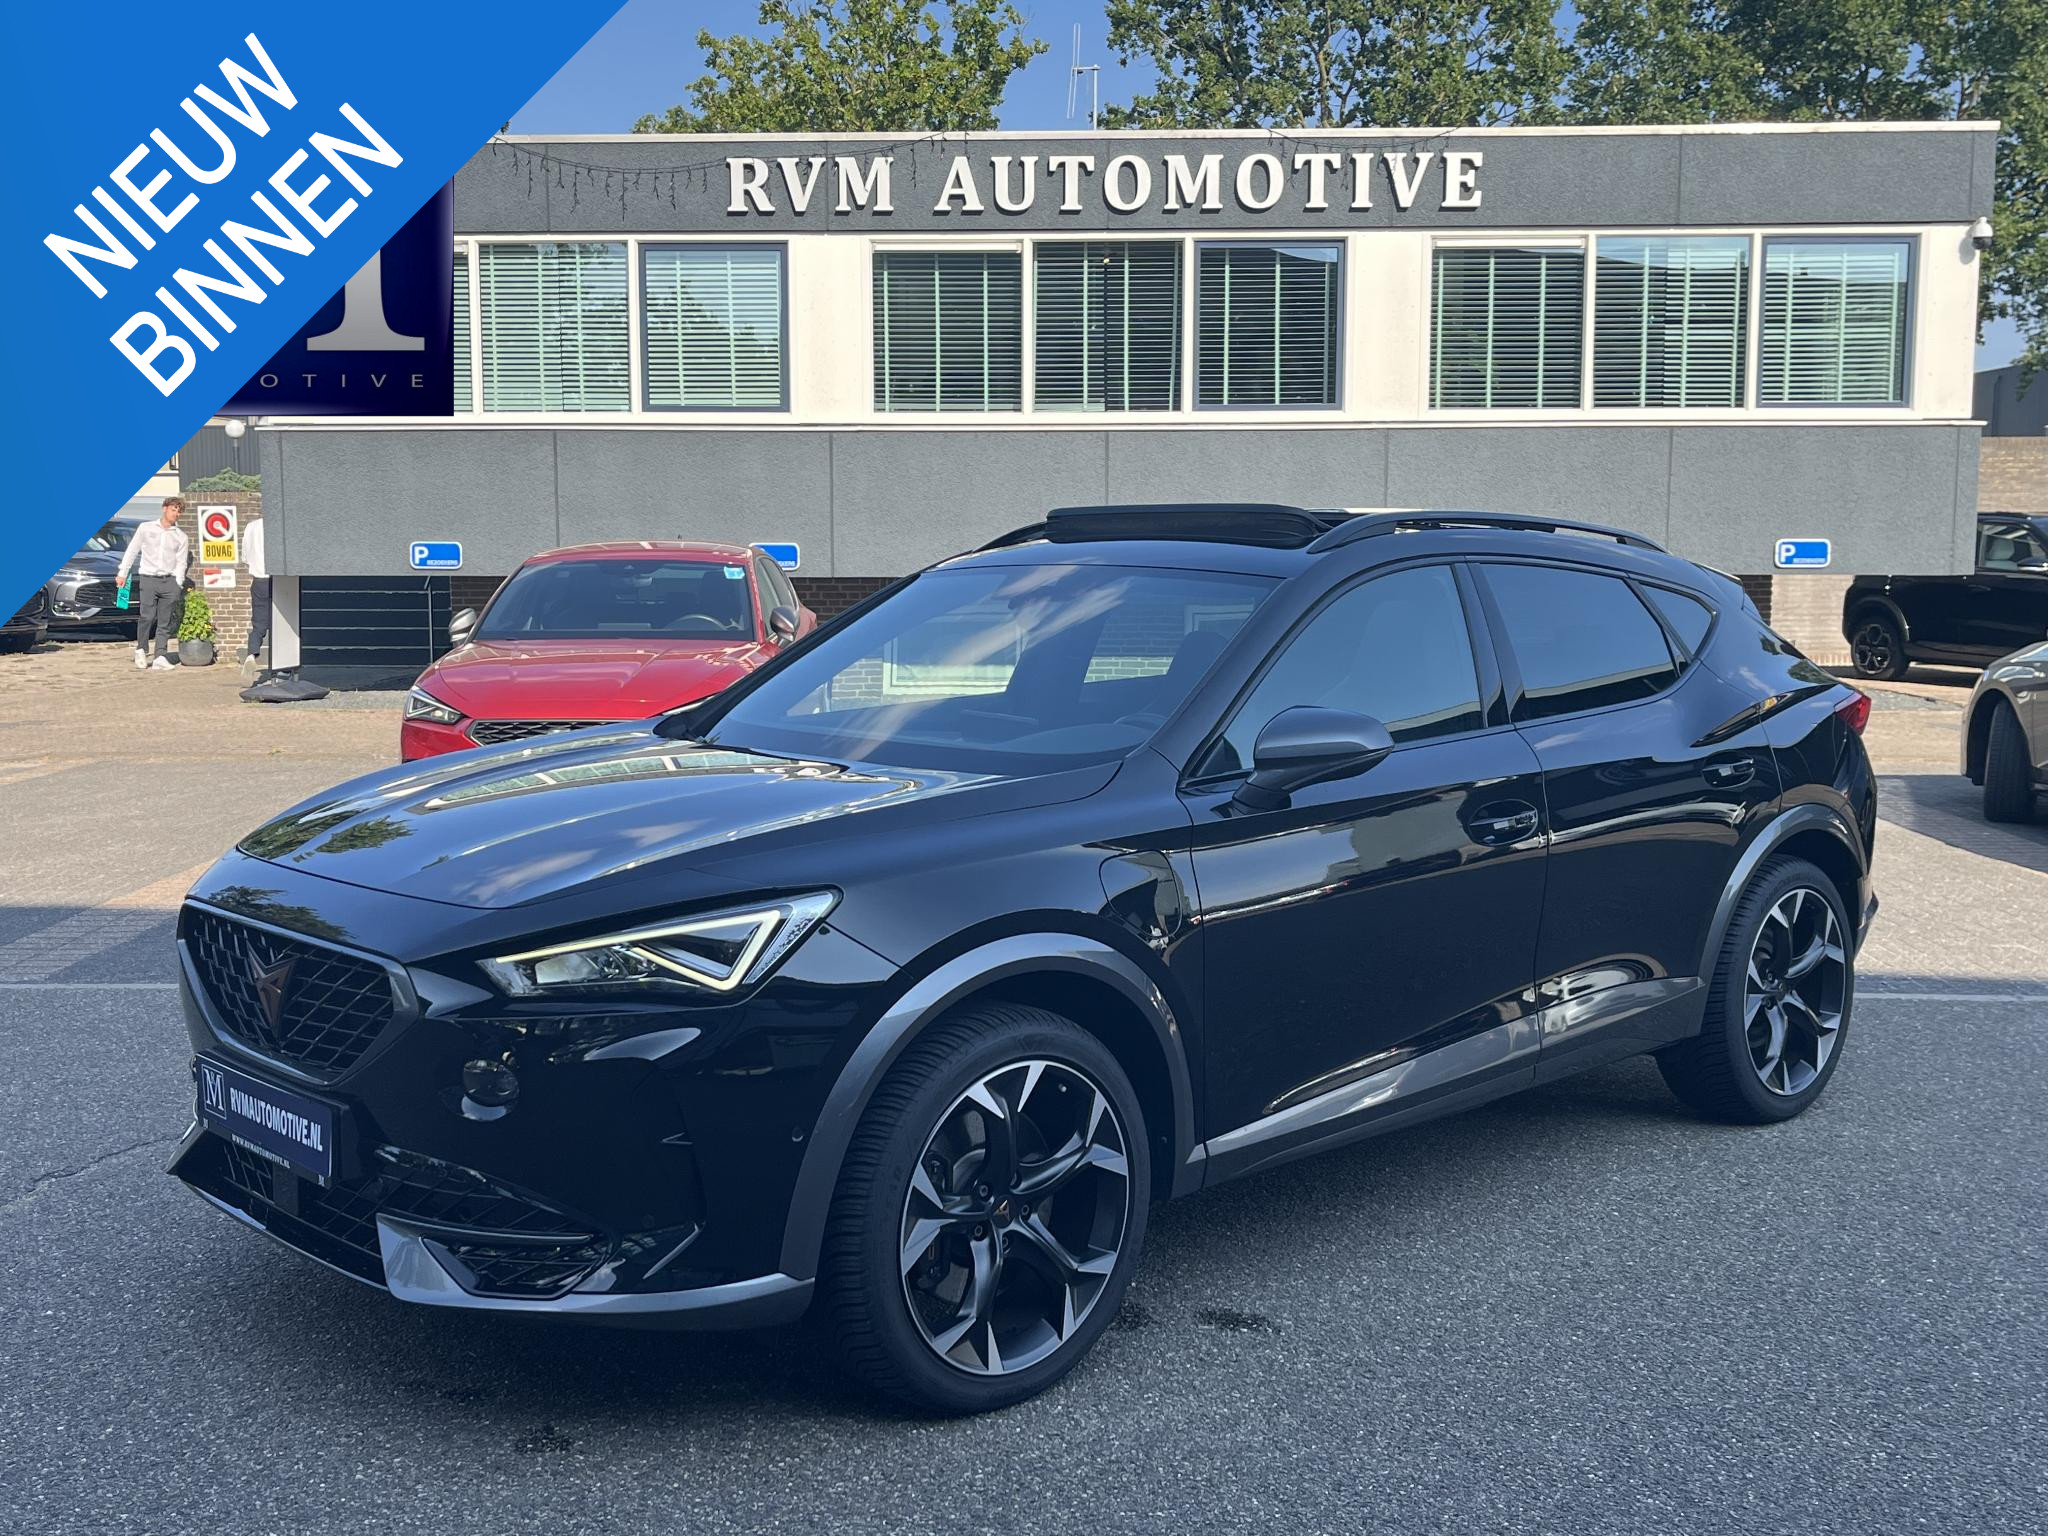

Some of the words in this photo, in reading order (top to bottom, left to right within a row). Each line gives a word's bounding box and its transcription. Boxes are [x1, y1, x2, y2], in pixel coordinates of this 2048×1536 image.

[726, 156, 894, 214] RVM
[934, 152, 1484, 212] AUTOMOTIVE
[205, 545, 232, 558] BOVAG
[414, 546, 429, 565] P
[1780, 544, 1796, 563] P
[230, 1087, 323, 1152] RVMAUTOMOTIVE.NL
